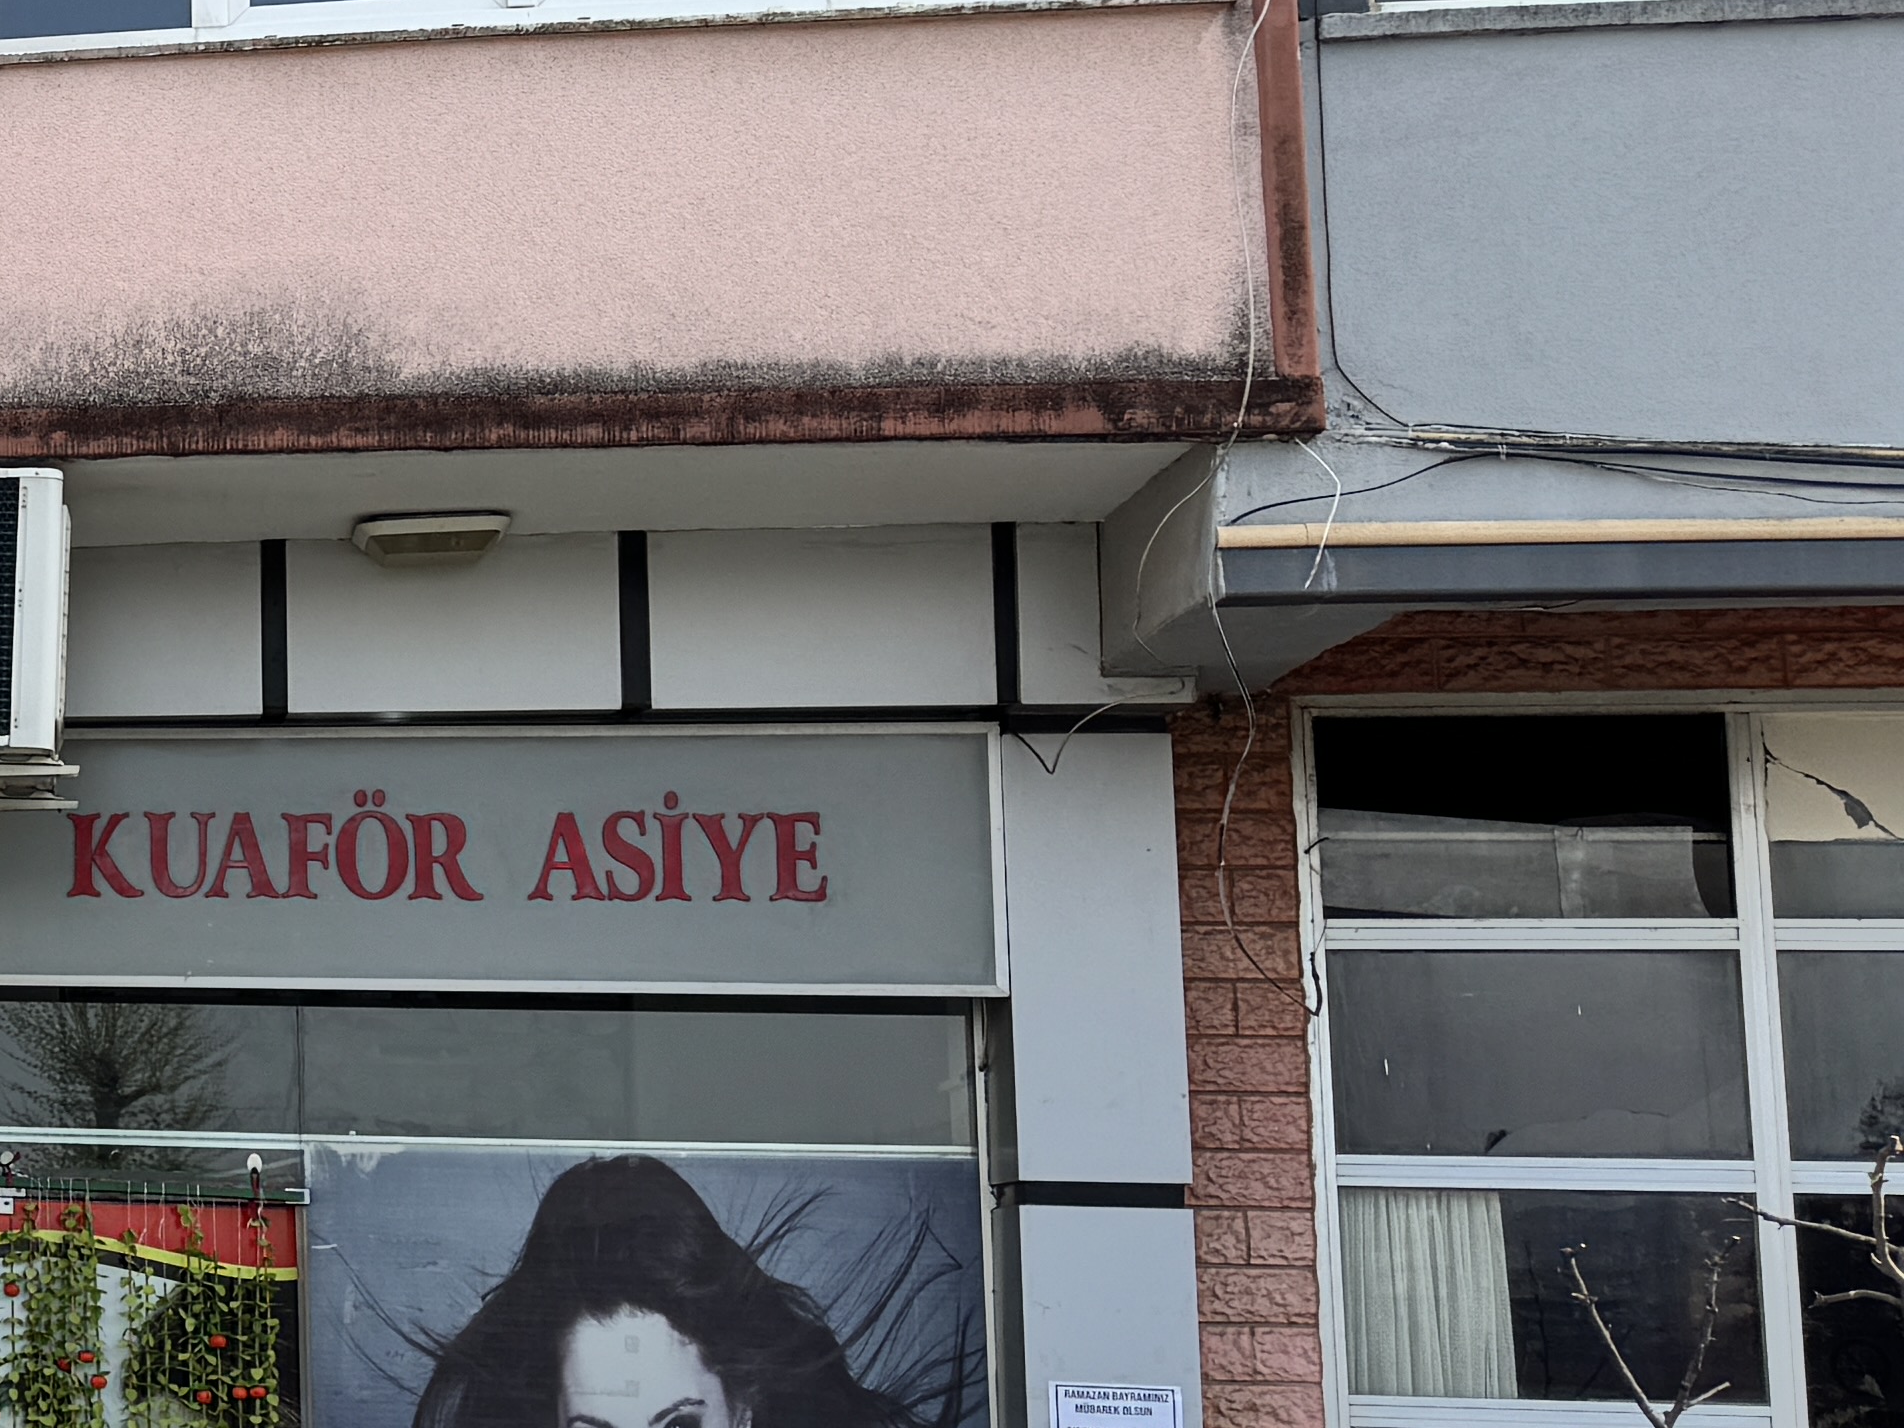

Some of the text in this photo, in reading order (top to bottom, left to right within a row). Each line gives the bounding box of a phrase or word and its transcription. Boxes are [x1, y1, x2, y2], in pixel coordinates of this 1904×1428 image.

[65, 787, 830, 903] KUAFÖR ASİYE
[1064, 1389, 1110, 1400] RAMAZAN
[1075, 1403, 1152, 1416] MÜBAREK OLSUN
